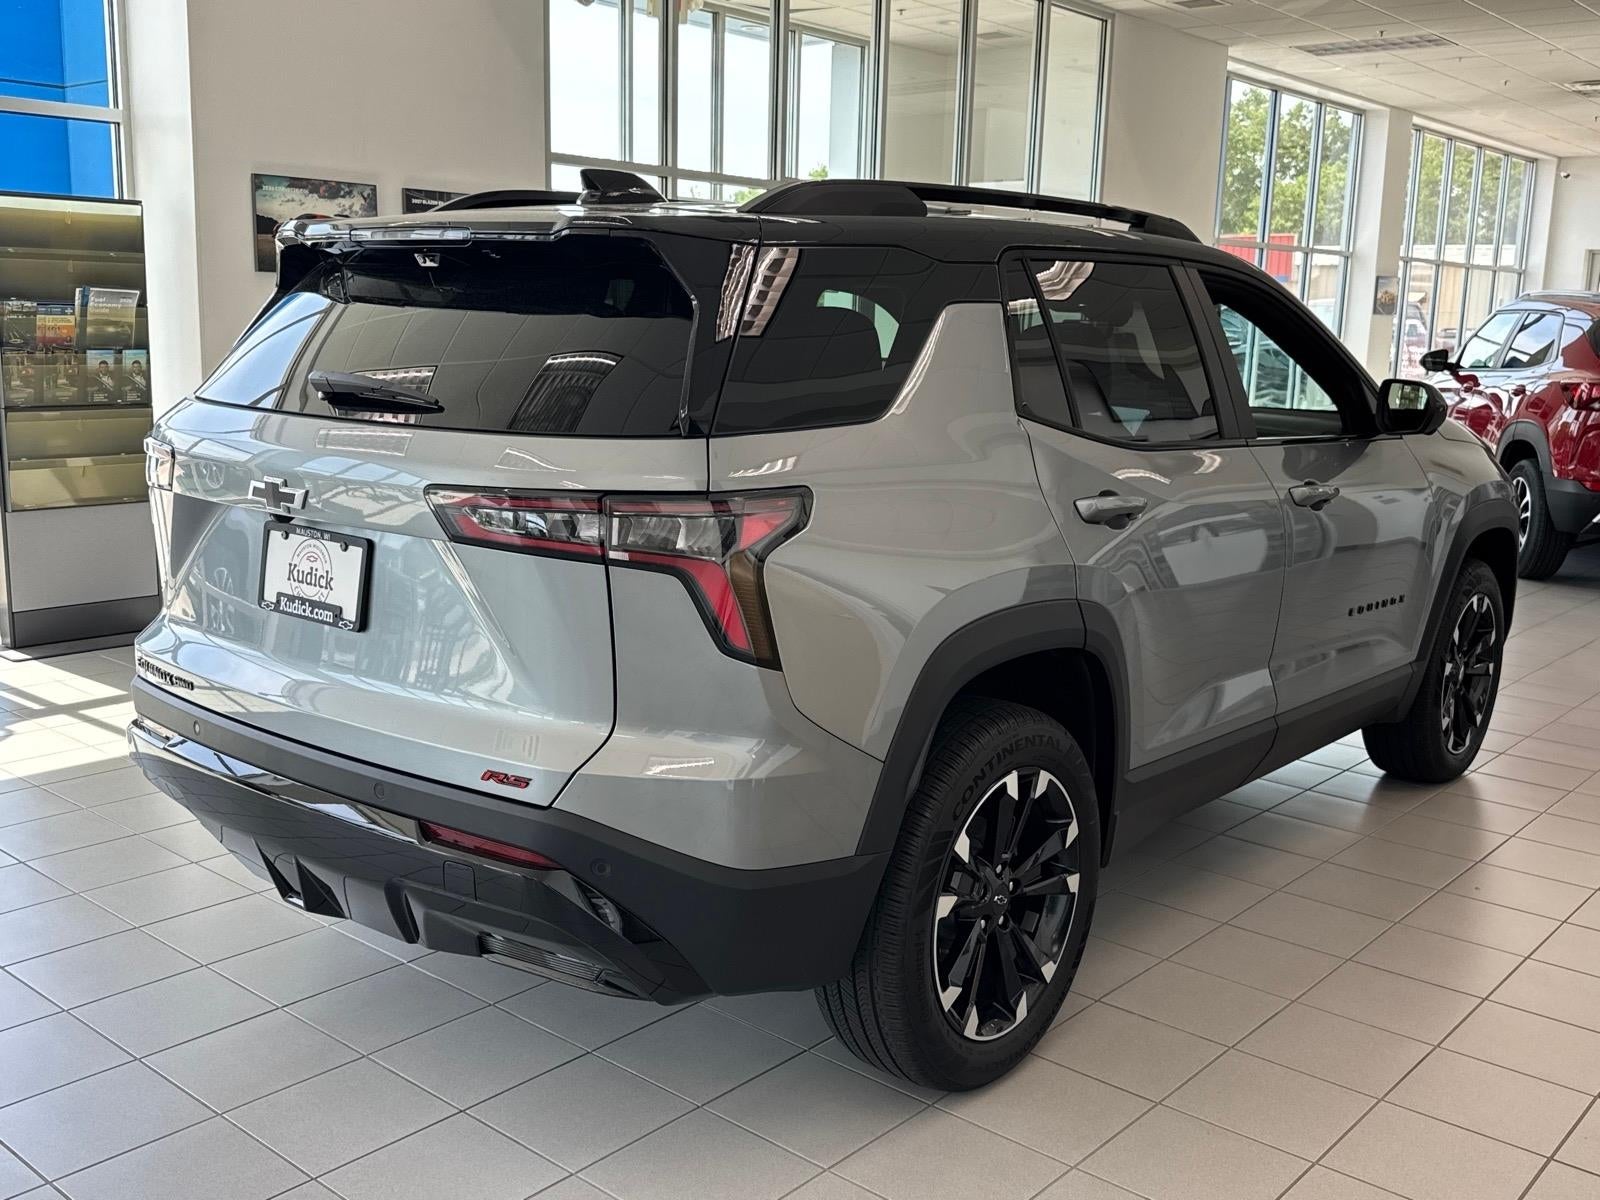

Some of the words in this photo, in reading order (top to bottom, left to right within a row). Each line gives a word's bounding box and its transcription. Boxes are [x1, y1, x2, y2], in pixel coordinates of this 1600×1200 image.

[296, 527, 322, 541] MAUSTON,
[287, 562, 334, 591] Kudick
[280, 596, 333, 623] Kudick.com
[480, 769, 533, 789] RS
[952, 733, 1062, 821] CONTINENTAL
